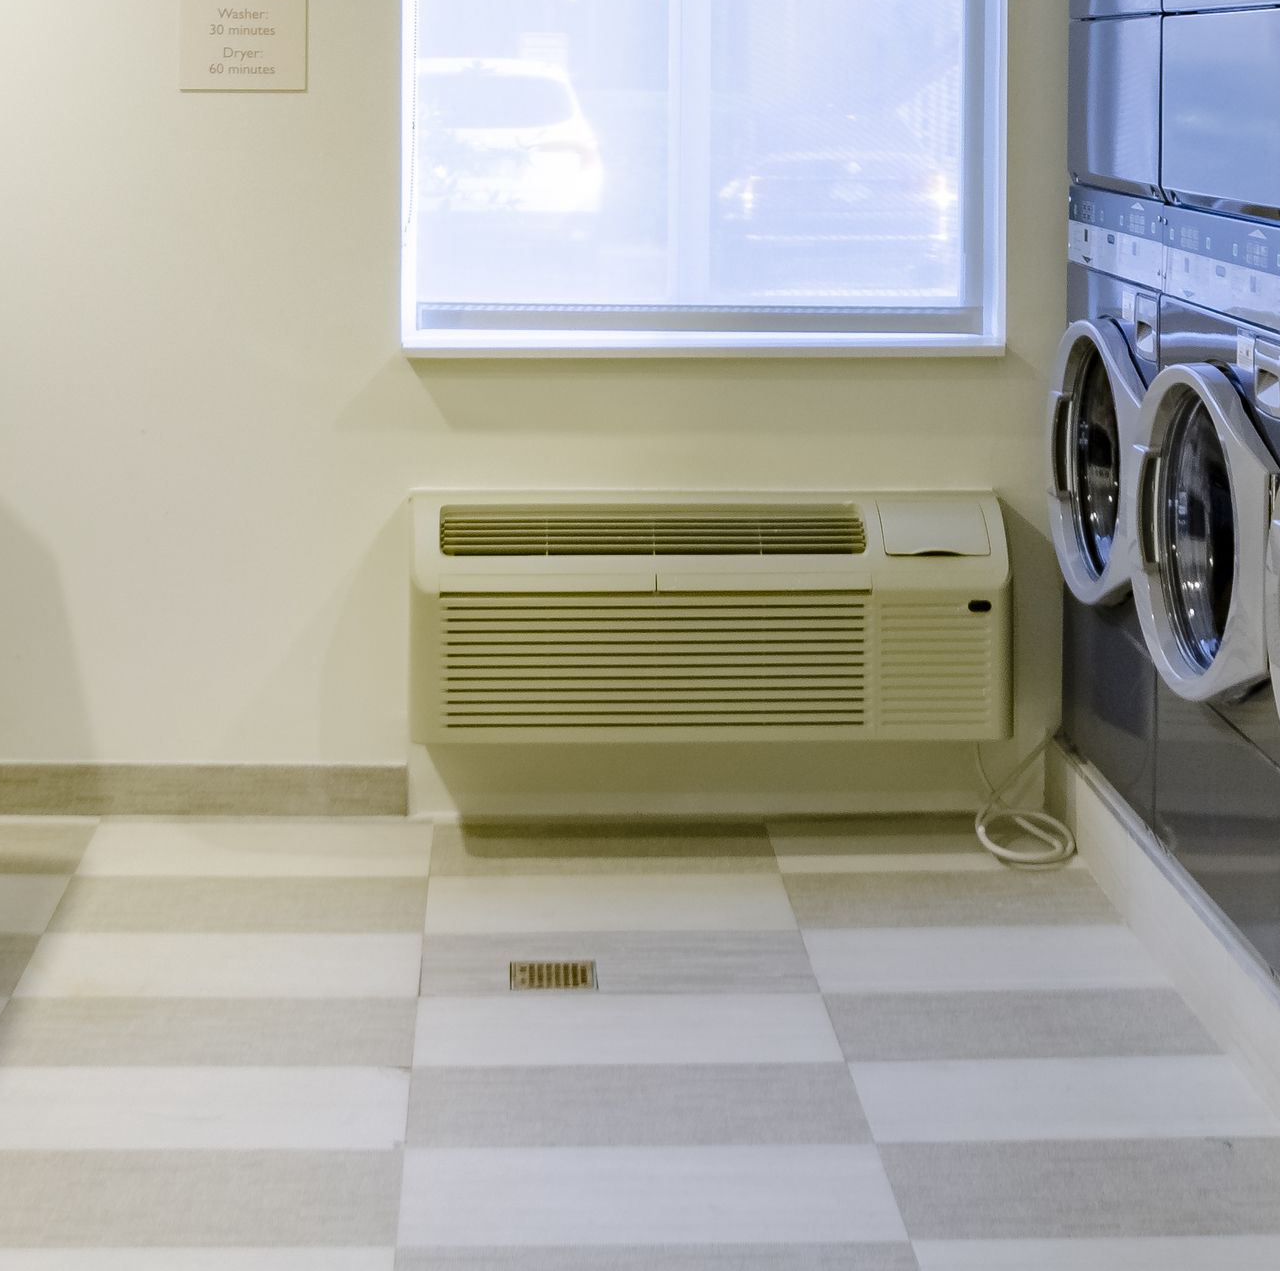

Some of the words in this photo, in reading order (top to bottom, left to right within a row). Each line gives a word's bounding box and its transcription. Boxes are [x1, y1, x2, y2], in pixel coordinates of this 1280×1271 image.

[218, 7, 269, 20] Washer:
[209, 23, 224, 36] 30
[228, 25, 276, 36] minutes
[223, 46, 264, 61] Dryer:
[209, 63, 224, 75] 60
[228, 65, 276, 75] minutes
